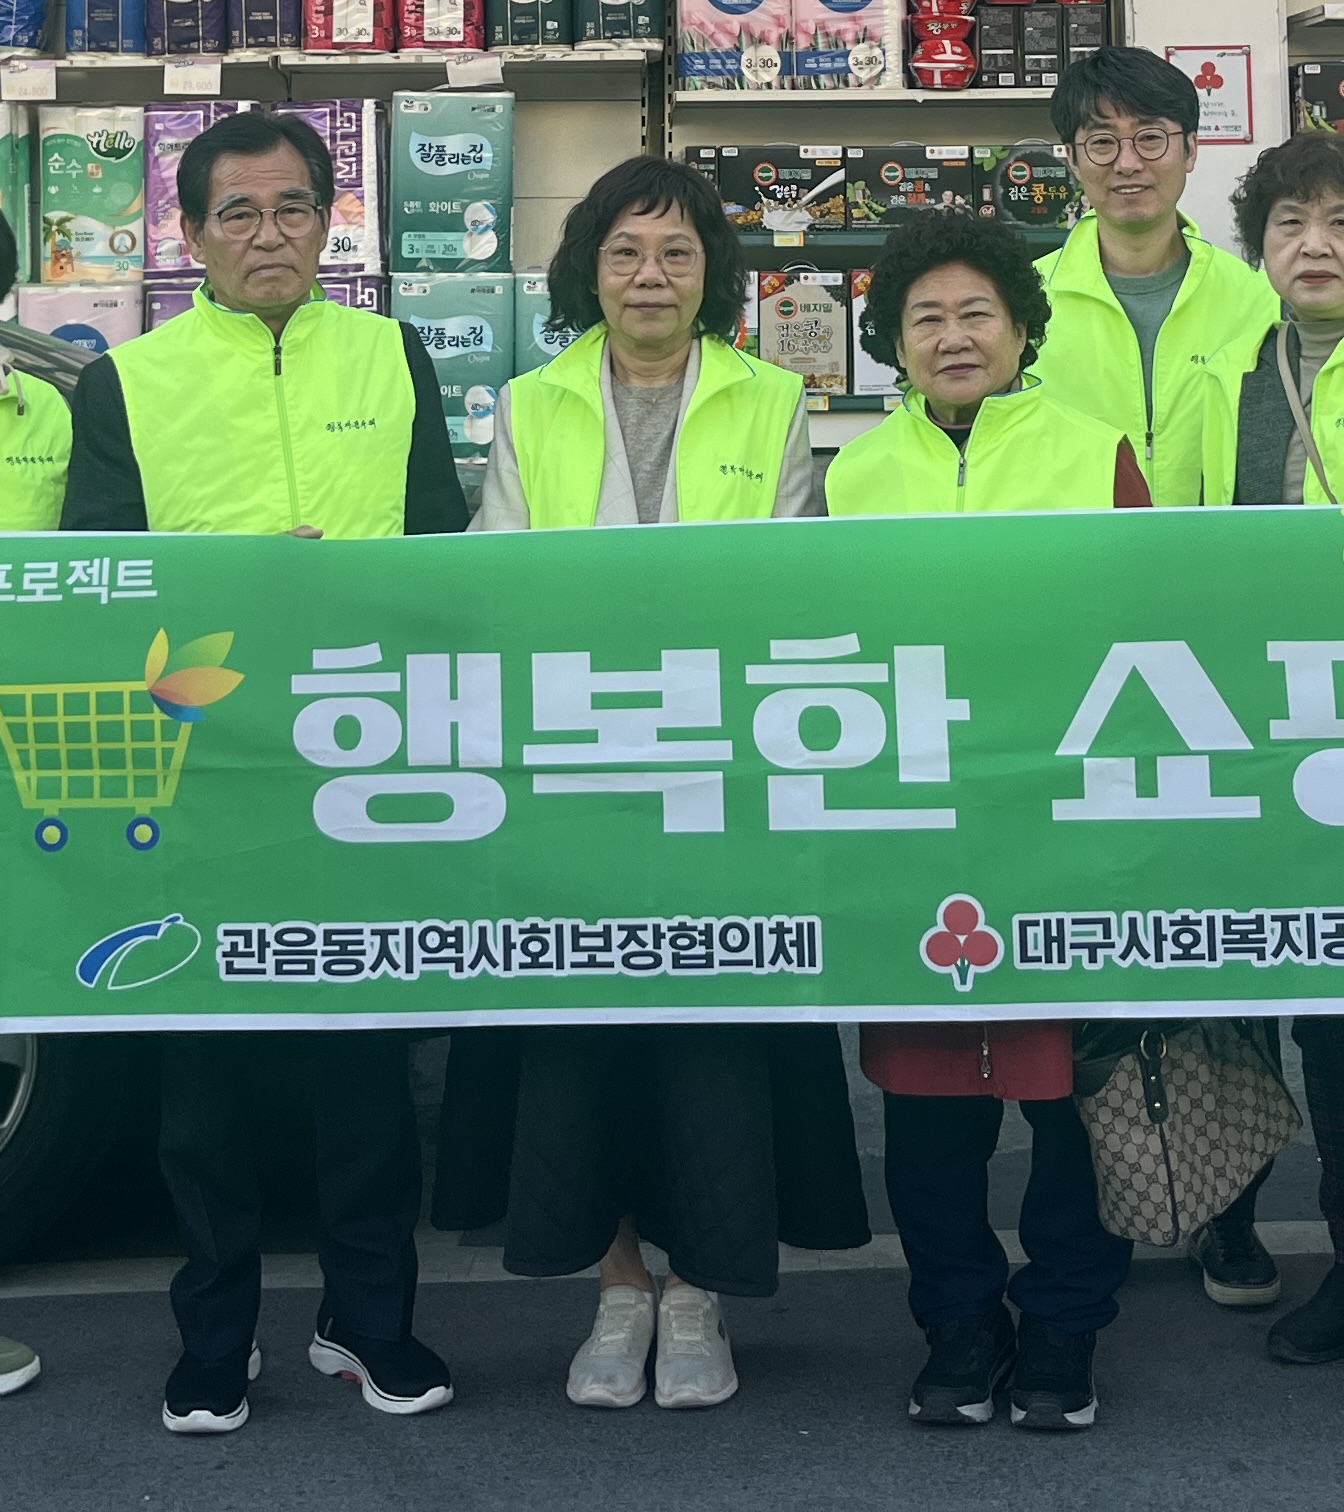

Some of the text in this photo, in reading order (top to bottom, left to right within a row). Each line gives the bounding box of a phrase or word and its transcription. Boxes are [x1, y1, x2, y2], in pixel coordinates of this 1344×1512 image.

[86, 129, 136, 151] Hello
[47, 153, 84, 178] 순수
[416, 143, 484, 166] 잘풀리는집
[428, 201, 462, 214] 화이트
[799, 302, 833, 314] 베지밀
[418, 325, 484, 350] 잘풀리는집
[440, 385, 463, 398] 이트
[291, 632, 971, 843] 행복한
[220, 918, 819, 979] 관음동지역사회보장협의체
